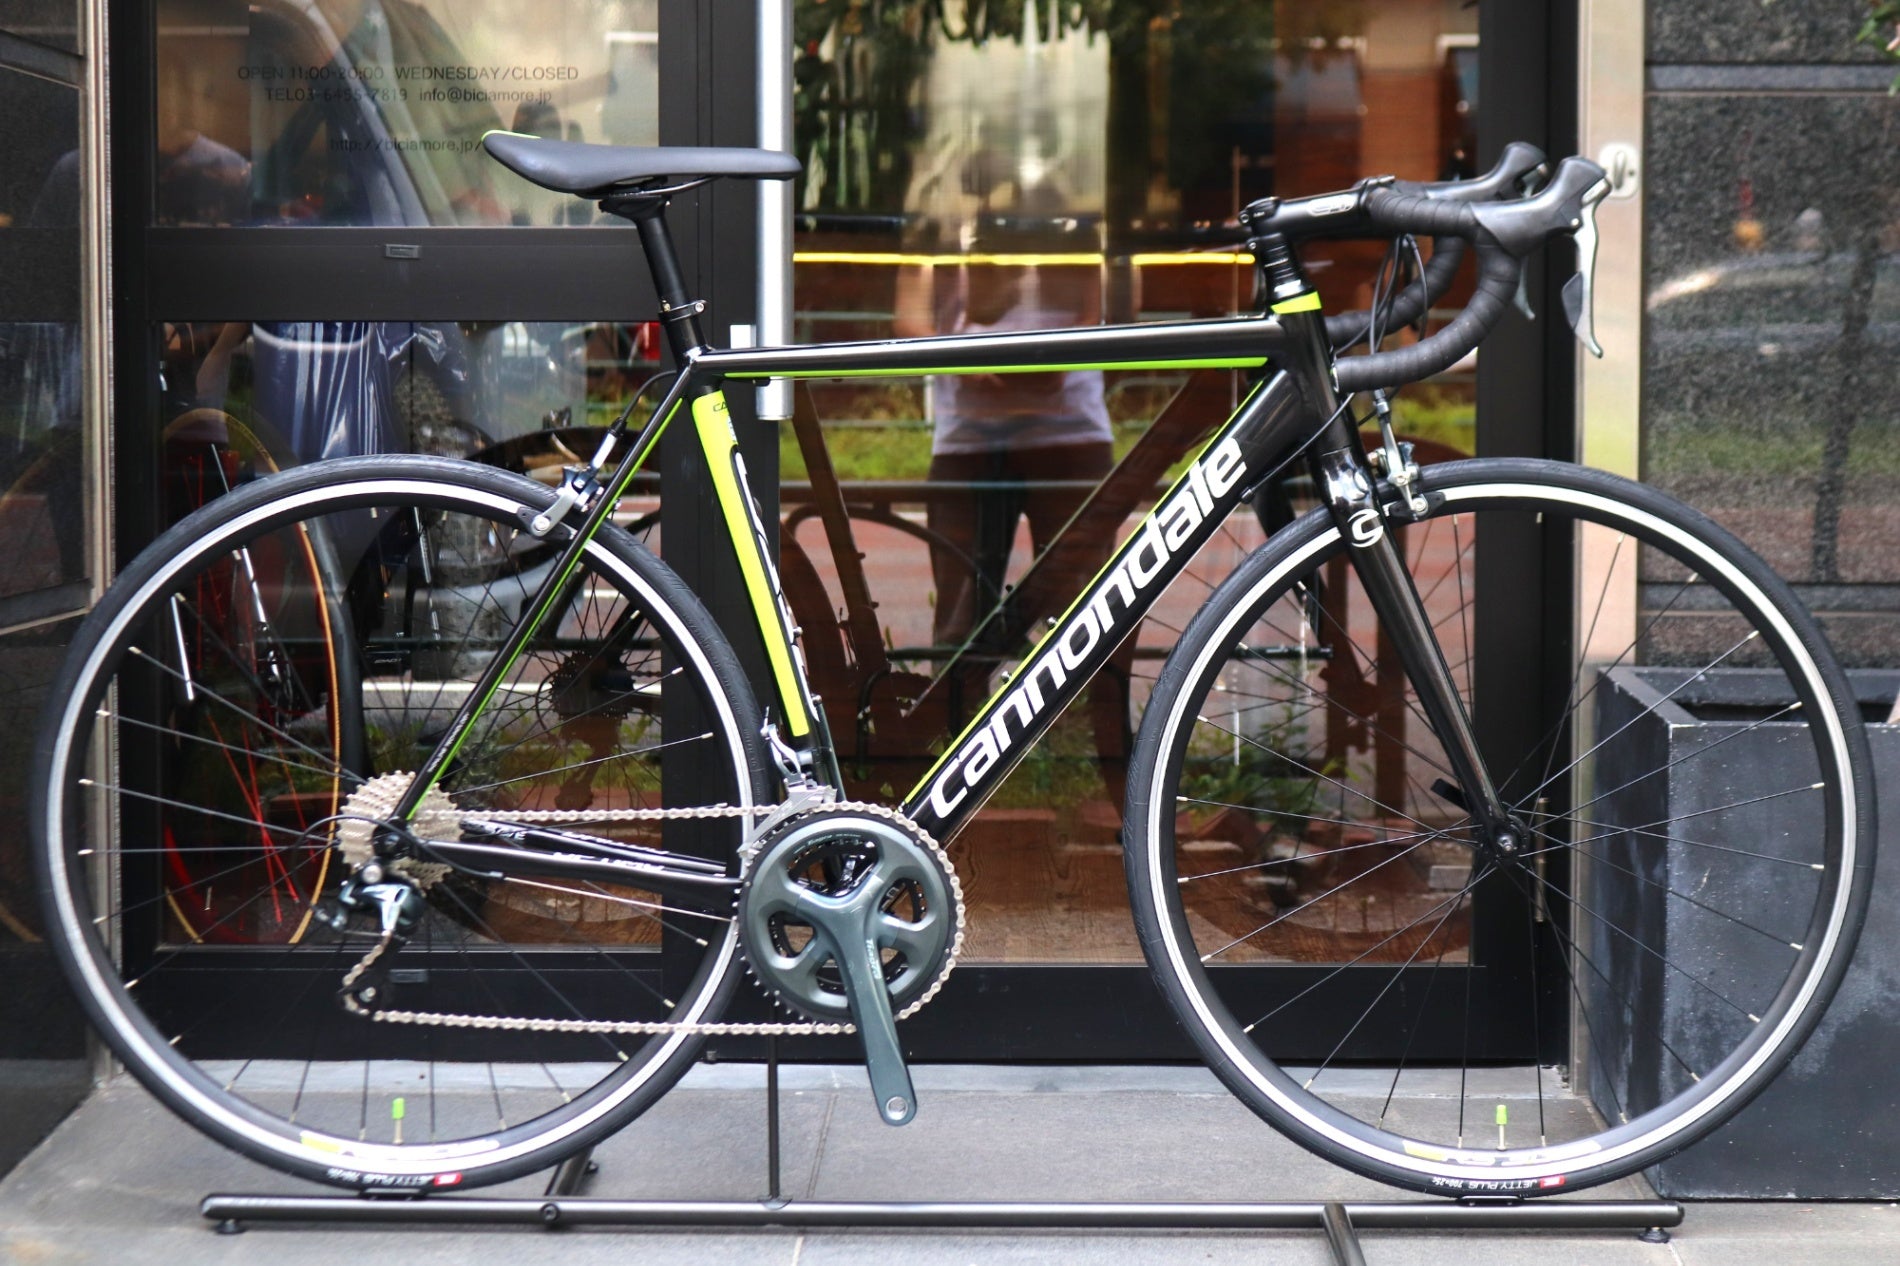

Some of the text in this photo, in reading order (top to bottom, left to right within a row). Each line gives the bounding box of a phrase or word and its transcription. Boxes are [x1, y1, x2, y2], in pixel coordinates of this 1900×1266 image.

[237, 66, 579, 81] OPEN 11:00-20:00 WEDNESDAY/CLOSED
[419, 88, 552, 105] info@biciamore.jp
[926, 436, 1248, 820] cannondale
[1468, 1180, 1499, 1190] PLUS
[1500, 1179, 1537, 1190] JETTY
